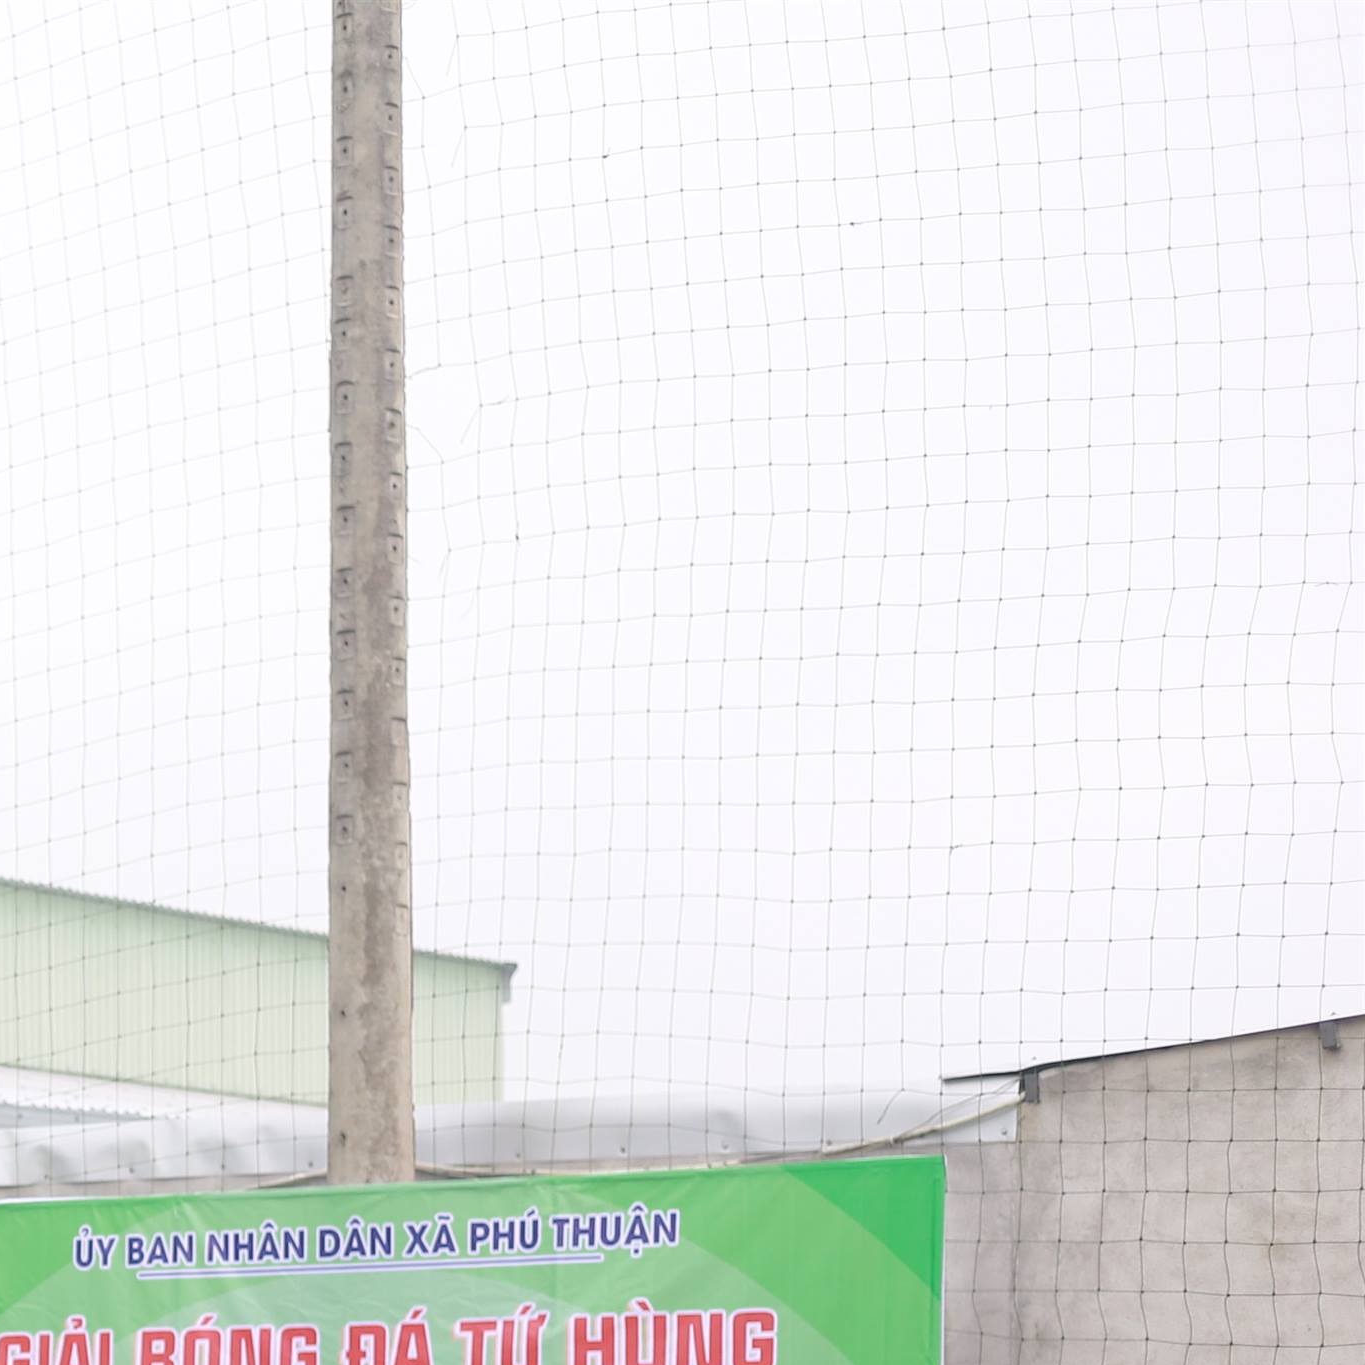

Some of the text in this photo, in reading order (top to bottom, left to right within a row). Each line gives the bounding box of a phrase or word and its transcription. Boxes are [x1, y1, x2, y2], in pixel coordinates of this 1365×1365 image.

[73, 1204, 678, 1268] ỦY BAN NHÂN DÂN XÃ PHÚ THUẬN
